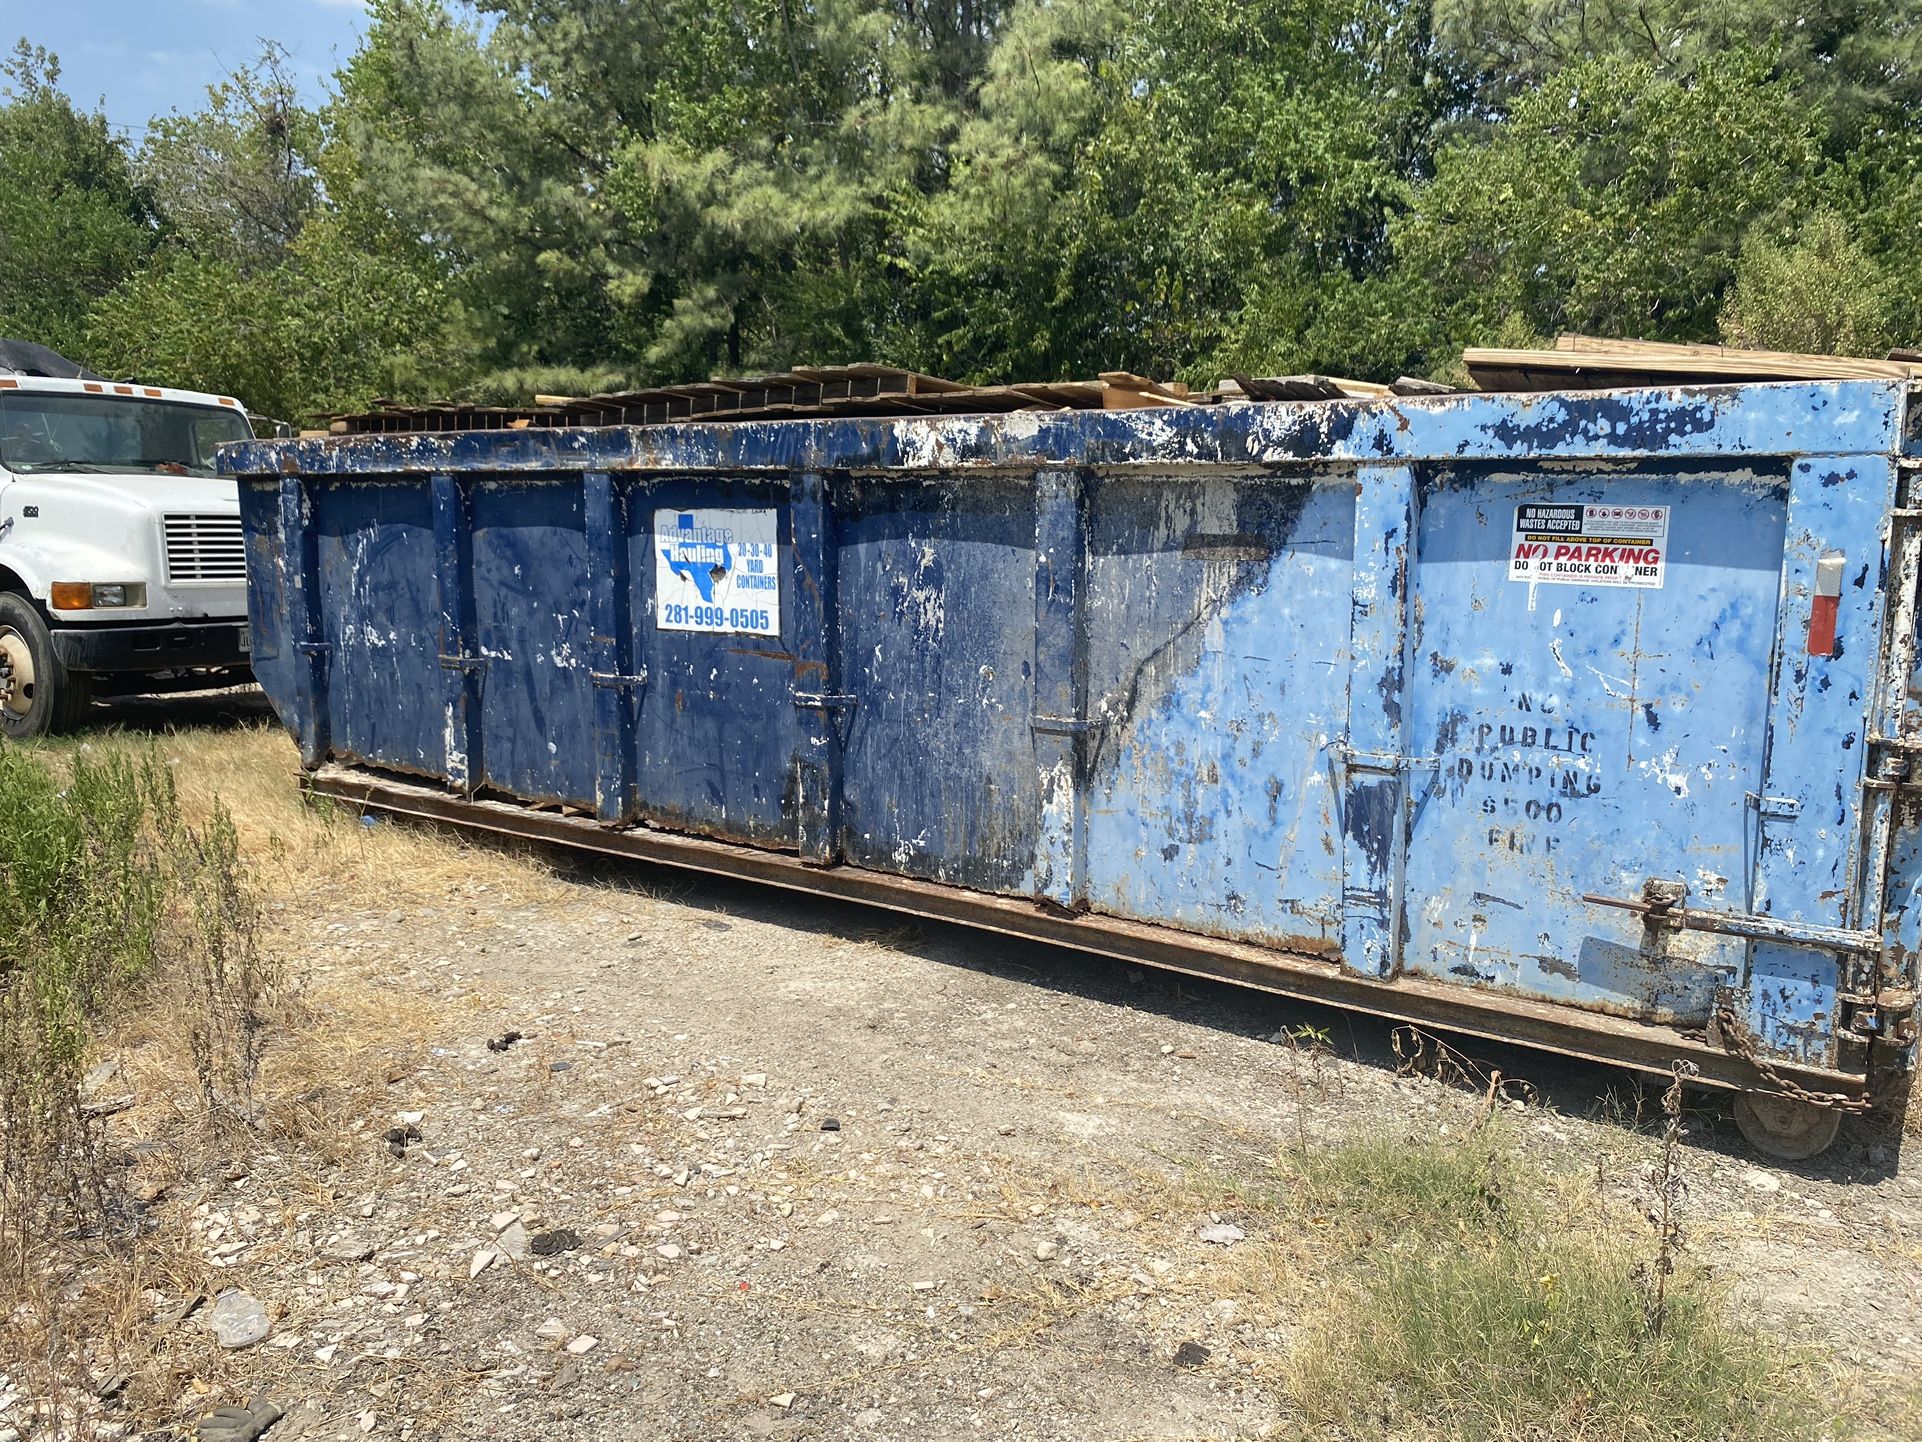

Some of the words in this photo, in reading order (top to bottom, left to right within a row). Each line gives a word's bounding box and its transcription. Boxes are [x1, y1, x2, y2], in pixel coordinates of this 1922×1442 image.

[1526, 508, 1536, 518] NO
[1537, 509, 1575, 519] HAZARDOUS
[1520, 519, 1546, 530] WASTES
[1547, 519, 1580, 531] ACCEPTED
[660, 525, 733, 545] Advantage
[670, 544, 725, 565] Hauling
[1515, 543, 1549, 560] NO
[1554, 544, 1660, 565] PARKING
[746, 559, 764, 573] YARD
[1514, 560, 1529, 570] DO
[1556, 562, 1592, 573] BLOCK
[1595, 564, 1658, 577] CONNER
[736, 575, 776, 590] CONTAINERS
[665, 604, 769, 629] 281-999-0505
[1478, 723, 1595, 753] PUBLIC
